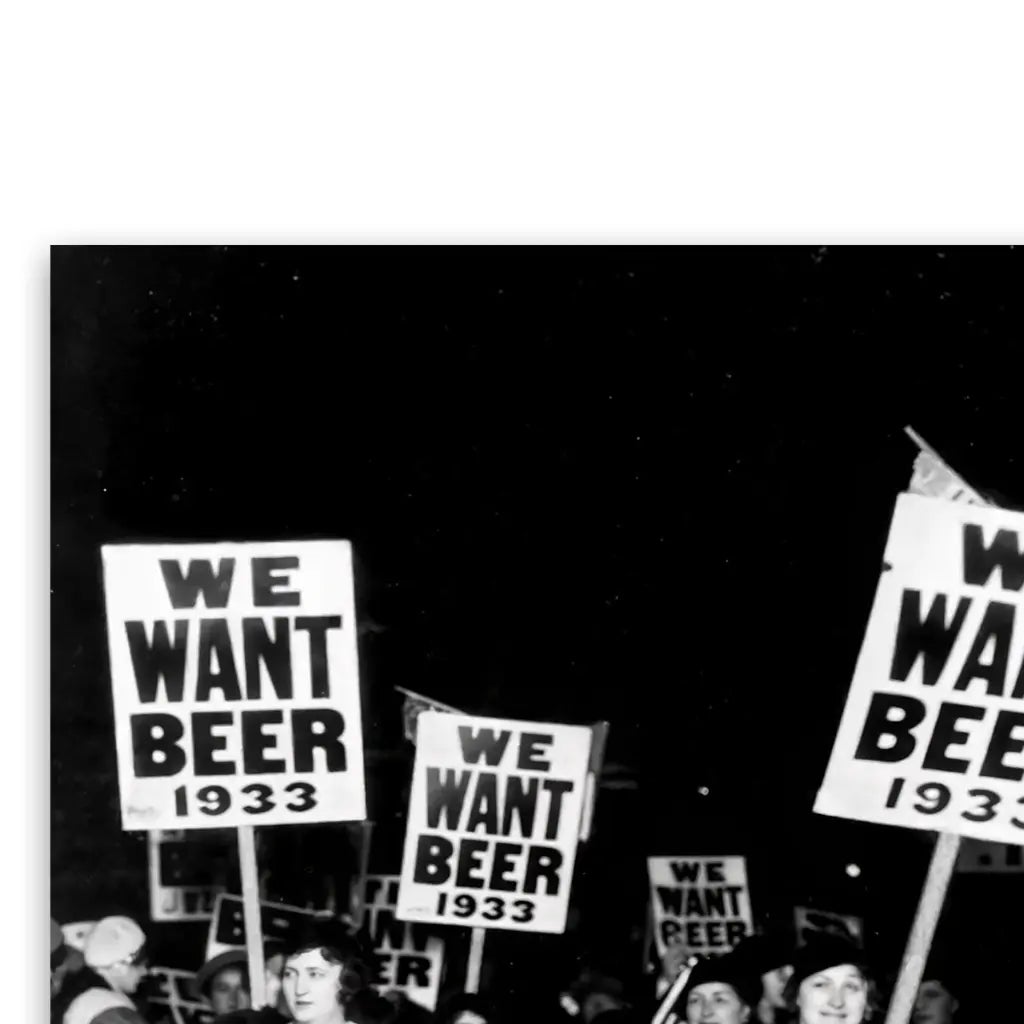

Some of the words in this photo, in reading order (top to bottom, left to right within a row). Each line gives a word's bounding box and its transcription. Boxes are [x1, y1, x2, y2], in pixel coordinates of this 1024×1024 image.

[161, 557, 300, 608] WE
[125, 616, 341, 703] WANT
[131, 709, 346, 777] BEER
[459, 727, 553, 771] WE
[175, 782, 316, 816] 1933
[428, 769, 573, 840] WANT
[413, 835, 563, 896] BEER
[668, 862, 725, 882] WE
[437, 893, 535, 923] 1933
[656, 887, 742, 917] WANT
[368, 954, 431, 987] ER
